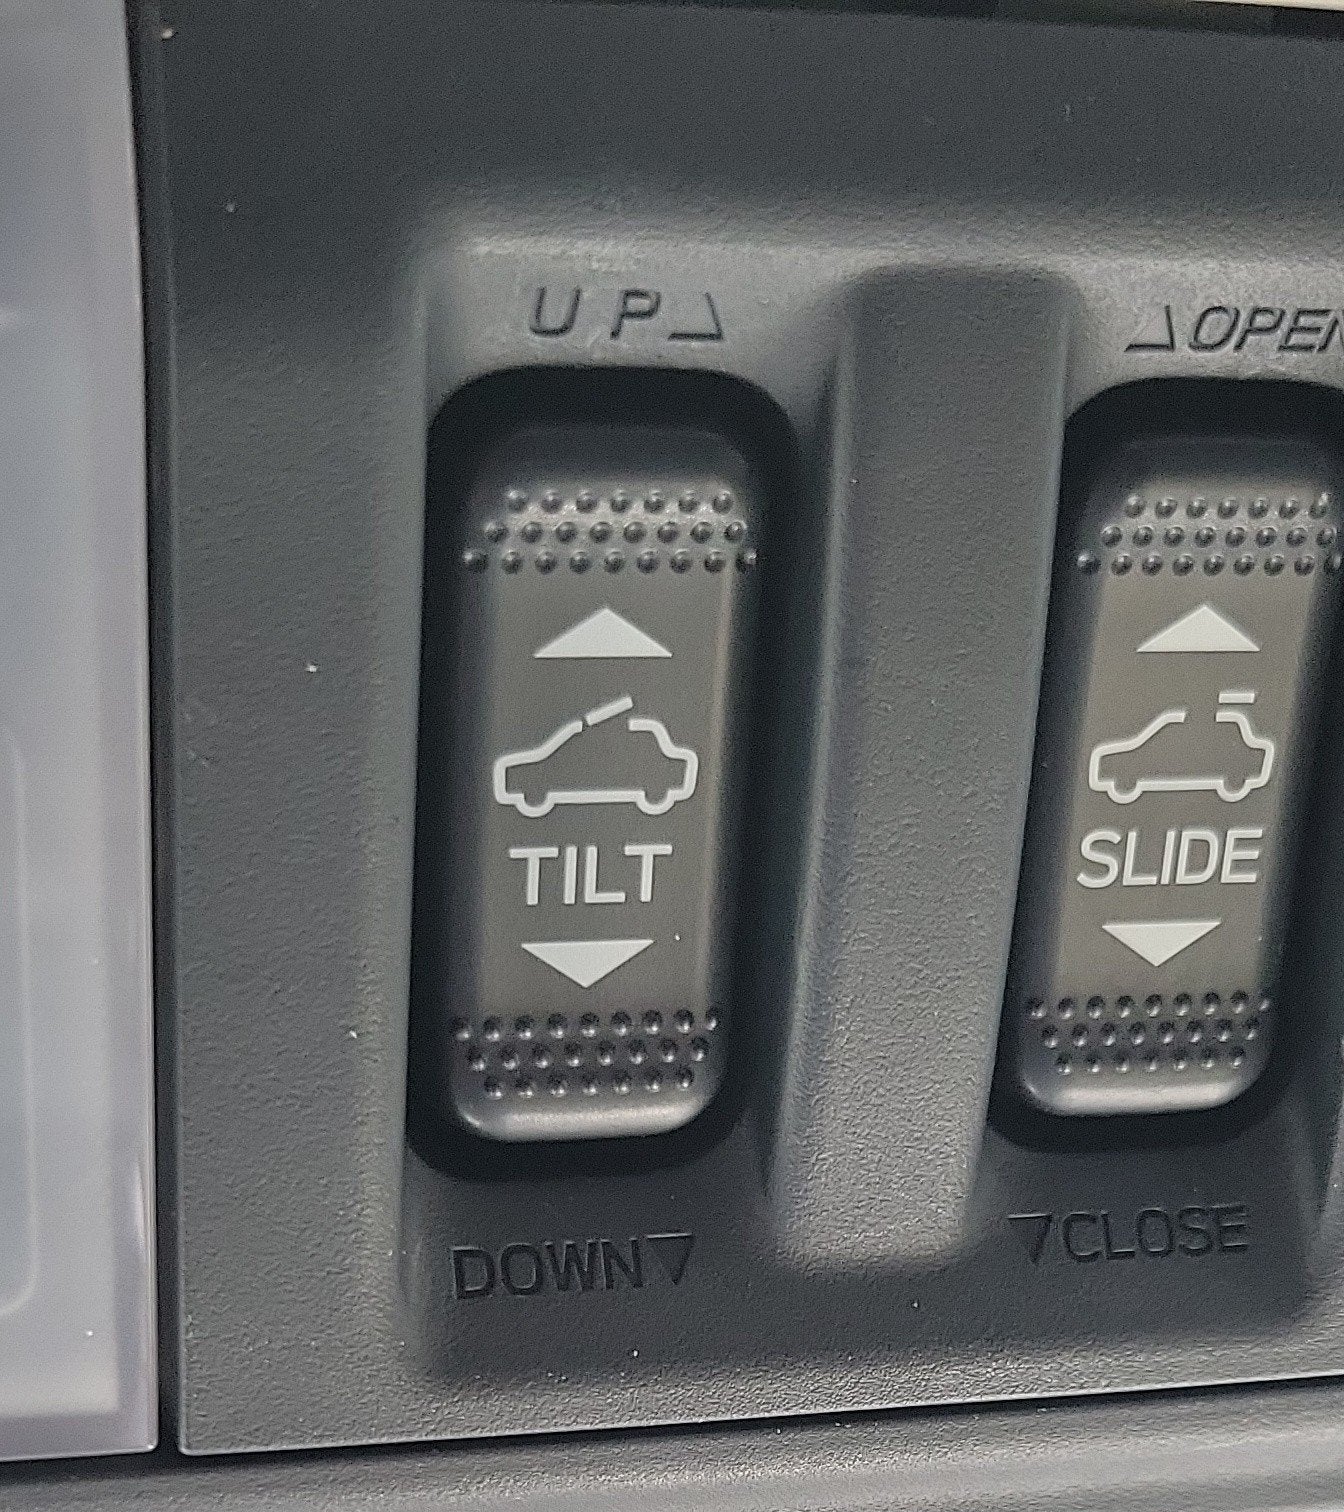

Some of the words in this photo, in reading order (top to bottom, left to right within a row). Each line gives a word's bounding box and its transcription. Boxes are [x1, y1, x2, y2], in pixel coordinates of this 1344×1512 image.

[526, 286, 661, 340] UP
[508, 843, 674, 907] TILT
[1076, 828, 1264, 890] SLIDE
[1061, 1203, 1250, 1263] CLOSE
[451, 1234, 645, 1302] DOWN
